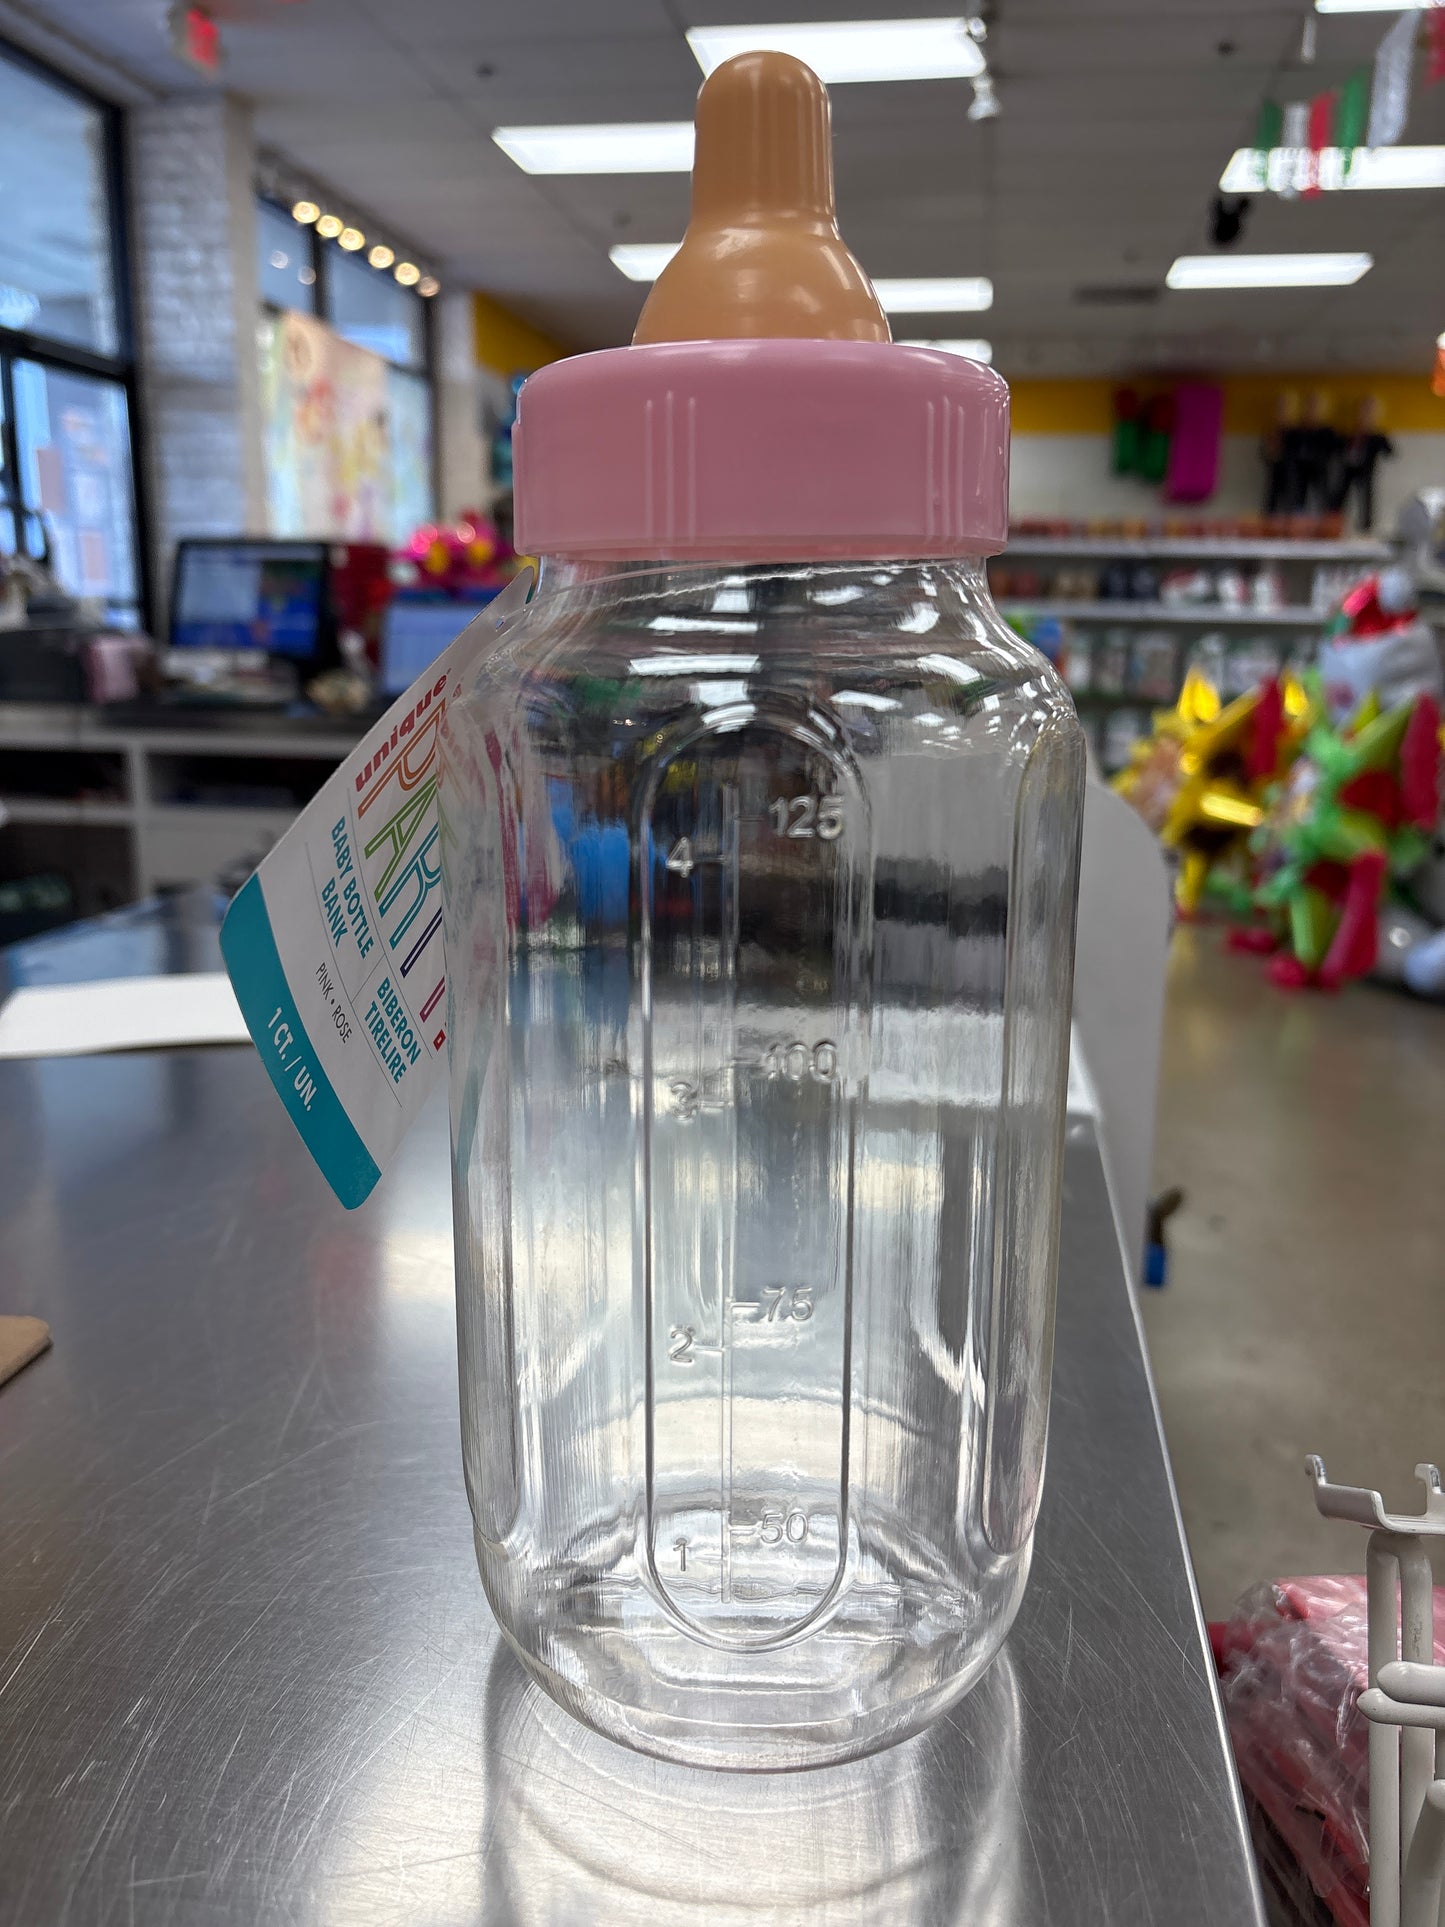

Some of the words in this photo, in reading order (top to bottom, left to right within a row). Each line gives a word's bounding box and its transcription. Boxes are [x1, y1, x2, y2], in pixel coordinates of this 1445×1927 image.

[355, 674, 448, 793] unique
[768, 794, 844, 840] 125
[665, 836, 694, 878] 4
[331, 816, 353, 880] BABY
[343, 876, 374, 959] BOTTLE
[321, 878, 350, 948] BANK
[267, 1007, 283, 1029] 1
[315, 962, 336, 1000] PINK
[331, 1005, 353, 1044] ROSE
[376, 977, 422, 1067] BIBERON
[274, 1022, 295, 1061] CT.
[363, 1001, 407, 1085] TIRELIRE
[762, 1039, 837, 1083] 100
[293, 1066, 318, 1112] UN.
[762, 1287, 814, 1322] 75
[669, 1328, 694, 1364] 2
[760, 1511, 809, 1544] 50
[672, 1538, 688, 1571] 1
